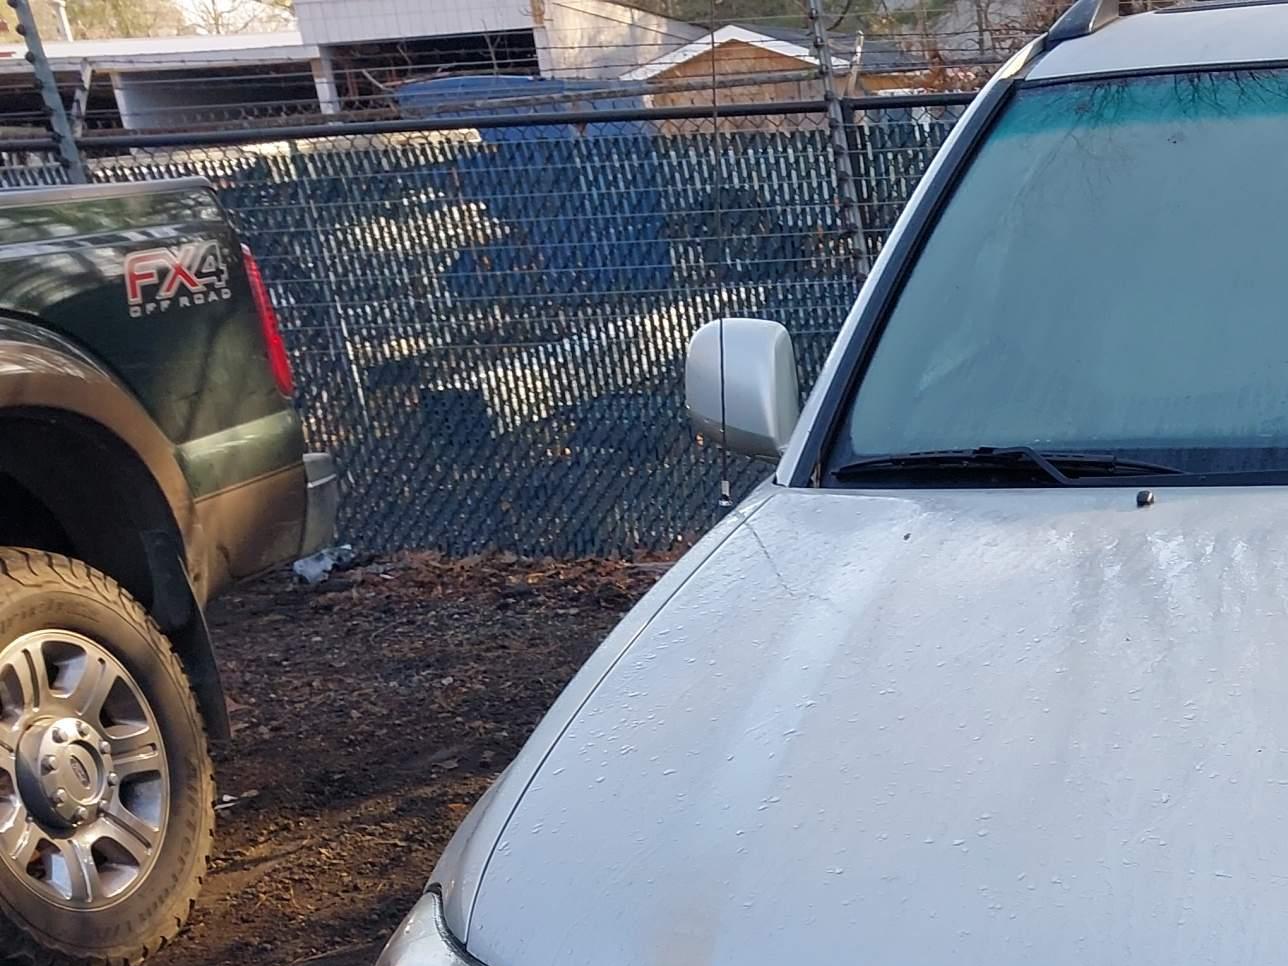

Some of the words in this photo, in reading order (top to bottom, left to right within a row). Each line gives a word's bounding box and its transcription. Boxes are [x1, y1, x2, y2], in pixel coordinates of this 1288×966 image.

[124, 239, 229, 305] FX4
[129, 300, 171, 318] OFF
[179, 288, 232, 308] ROAD
